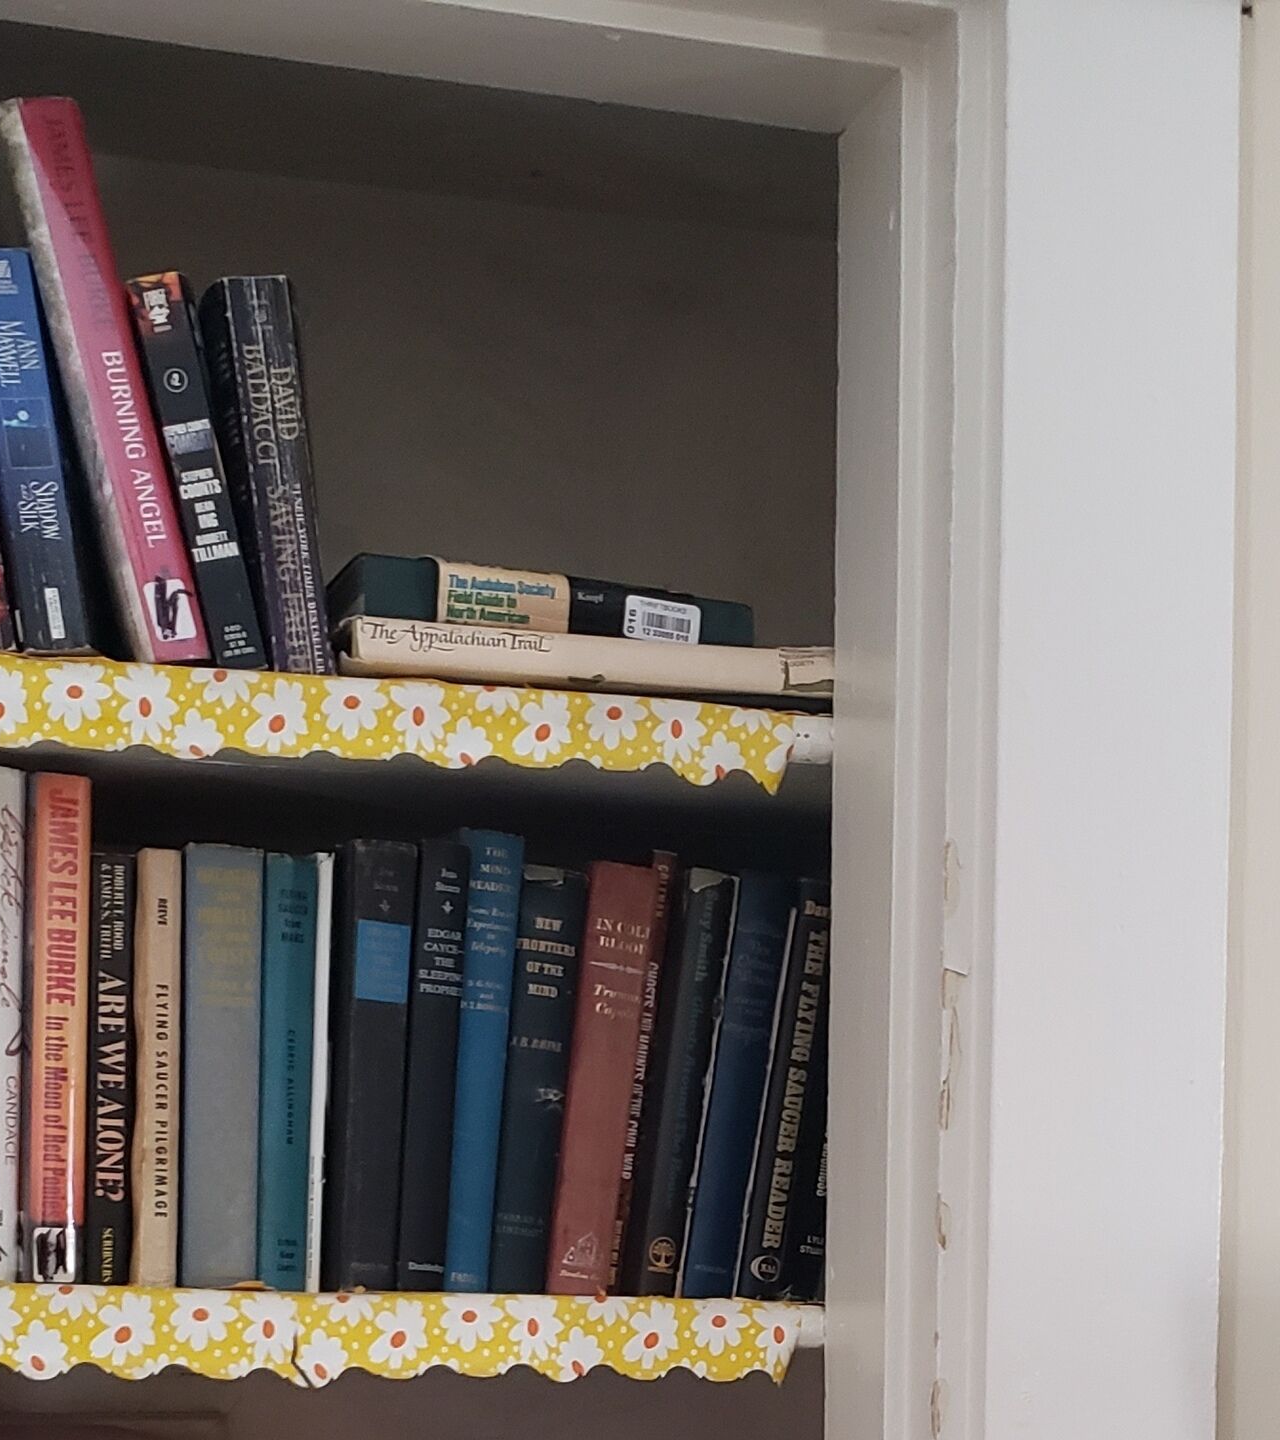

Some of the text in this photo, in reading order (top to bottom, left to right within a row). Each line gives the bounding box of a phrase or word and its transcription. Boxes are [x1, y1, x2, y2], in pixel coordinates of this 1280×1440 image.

[101, 349, 167, 549] BURNING ANGEL
[241, 343, 300, 465] DAVID BALDACCI
[18, 481, 61, 540] SHADOW SILK
[361, 622, 553, 653] The Appalachian Trail
[46, 787, 80, 1007] JAMES LEE BURKE
[427, 928, 463, 941] EDGAR
[534, 917, 562, 932] NEW
[527, 983, 559, 998] MIND
[94, 970, 127, 1203] ARE WE ALONE?
[154, 983, 169, 1219] FLYING SAUCER PILGRIMAGE
[761, 930, 828, 1249] THE FLYING SAUCER READER
